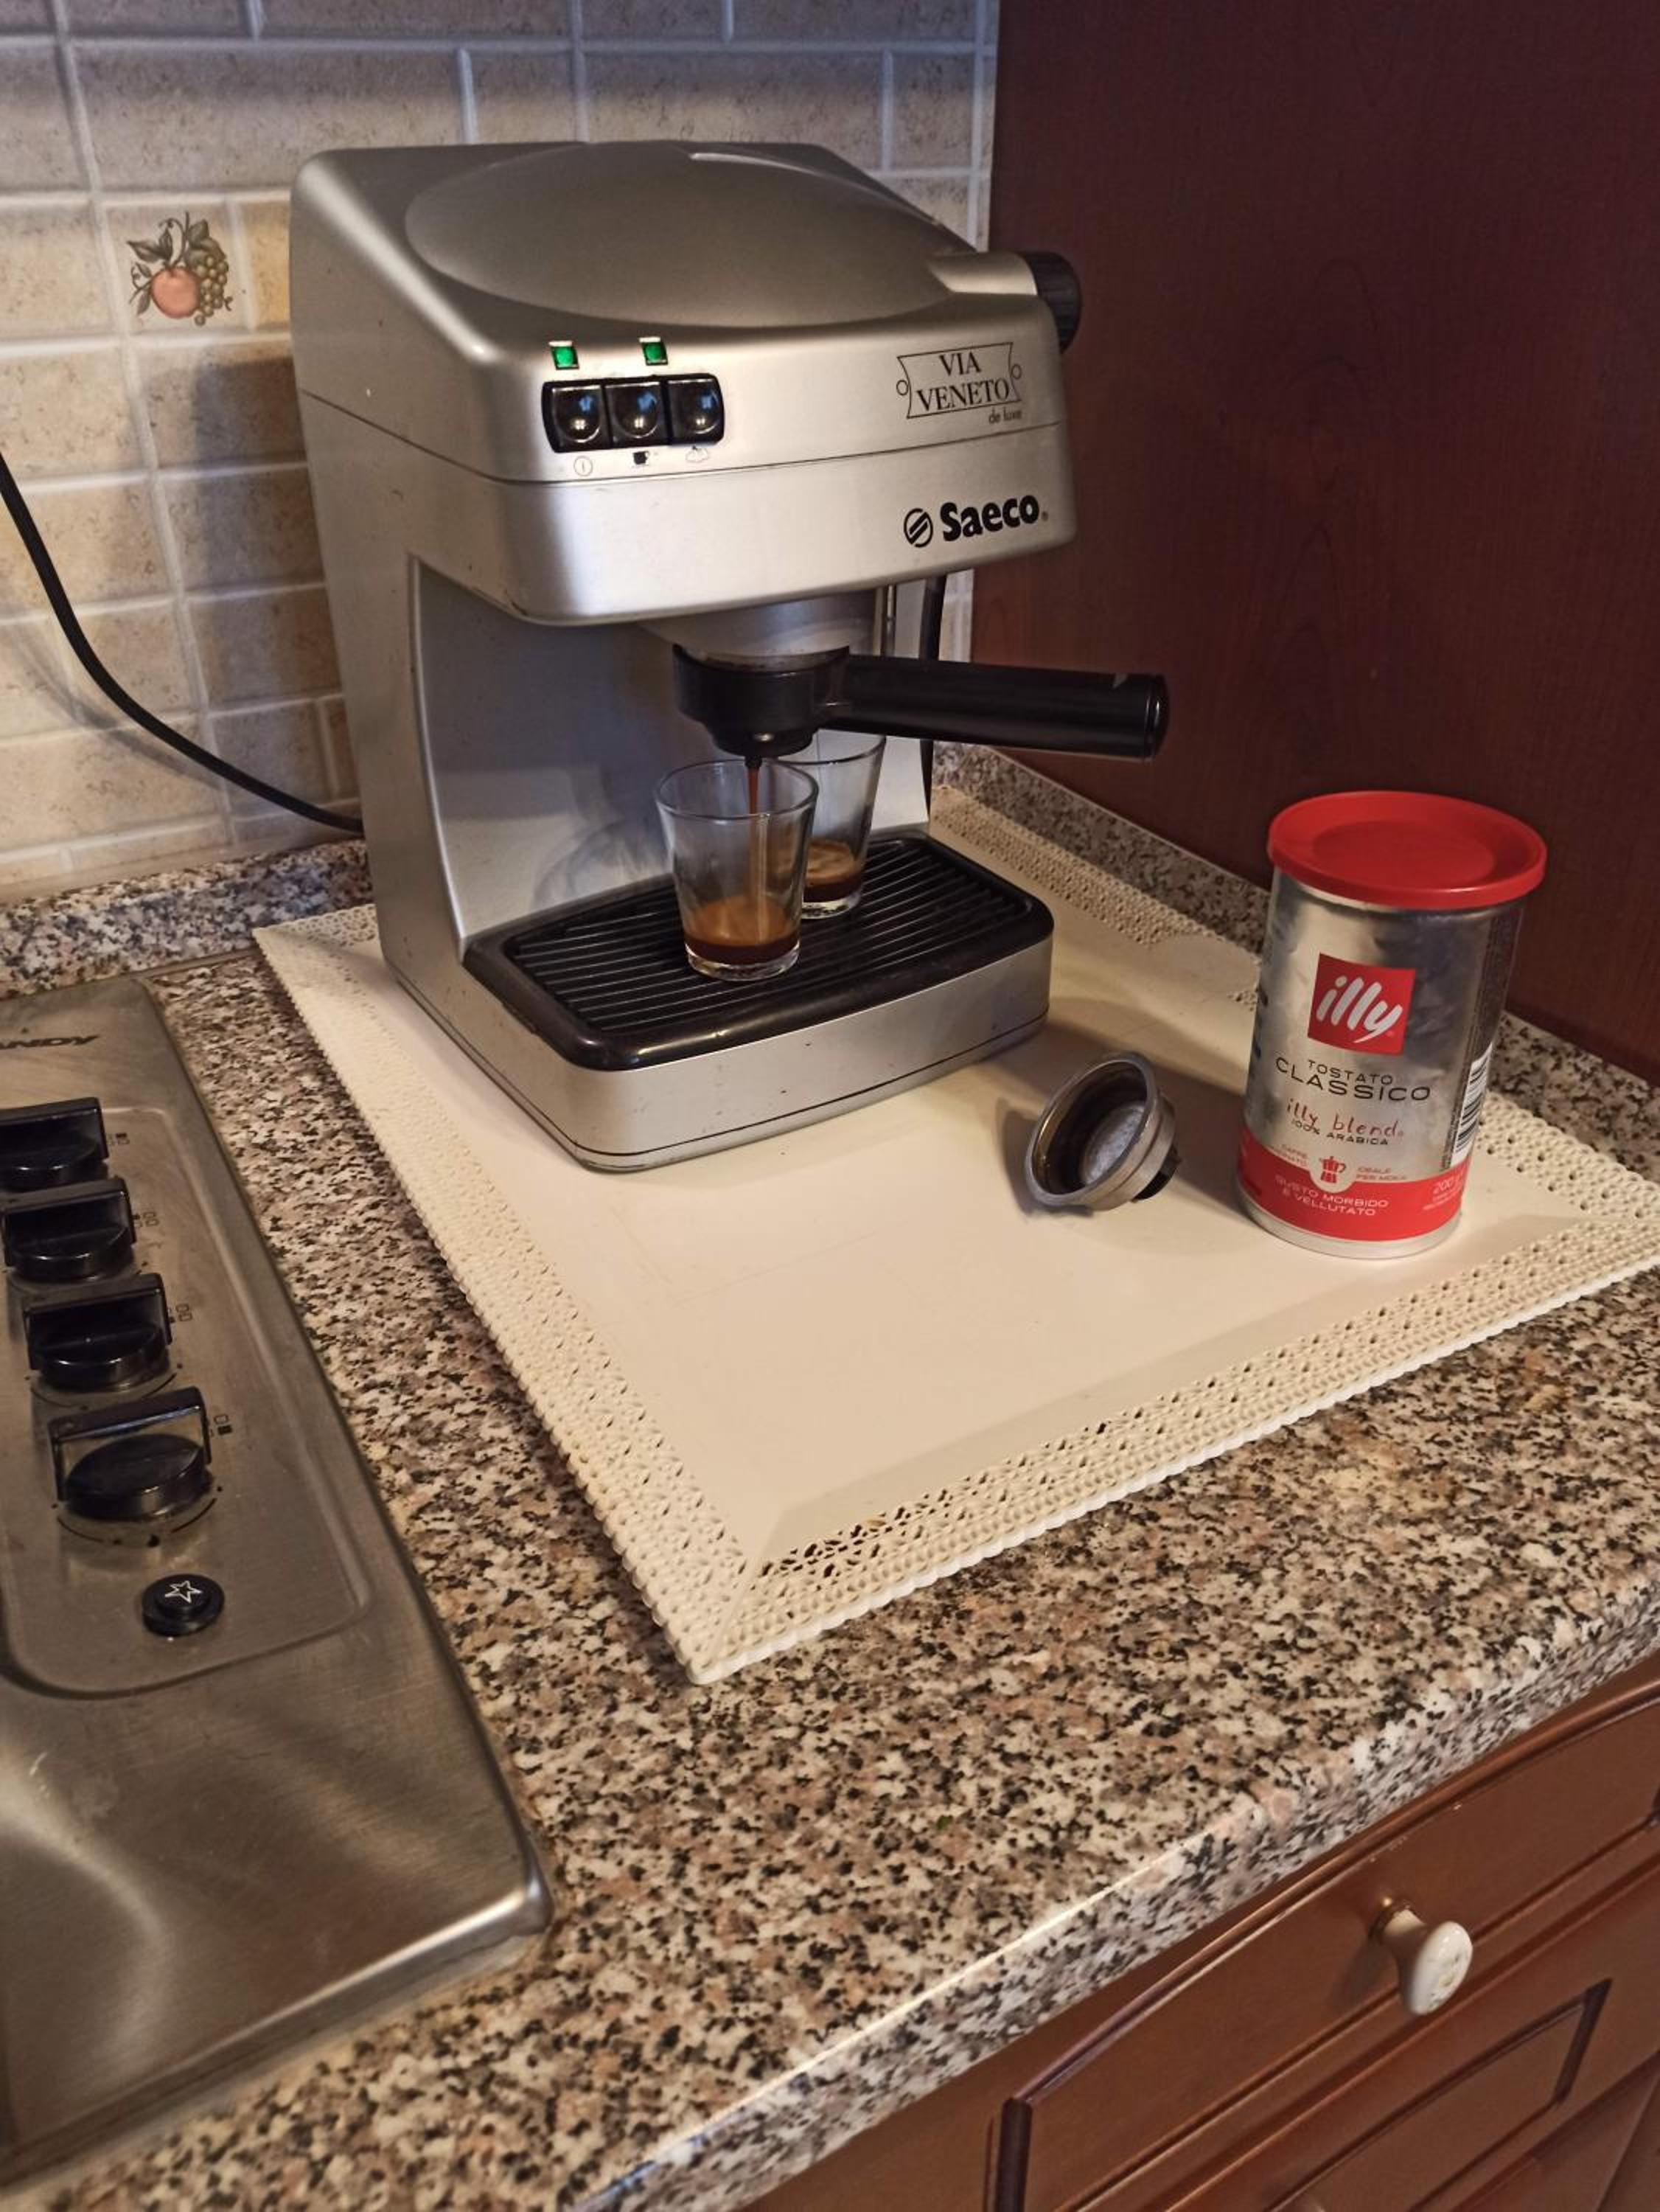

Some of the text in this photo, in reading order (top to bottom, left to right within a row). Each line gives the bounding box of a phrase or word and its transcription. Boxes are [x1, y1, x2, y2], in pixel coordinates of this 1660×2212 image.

[939, 352, 982, 376] VIA
[917, 378, 1010, 411] VENETO
[940, 495, 1040, 541] Saeco
[1316, 975, 1403, 1043] illy
[1275, 1057, 1431, 1102] CLASSICO
[1307, 1059, 1393, 1085] TOSTATO
[1287, 1098, 1399, 1137] illy blend
[1326, 1133, 1389, 1145] ARABICA
[1295, 1194, 1377, 1216] VELLUTATO
[1323, 1193, 1389, 1208] MORBIDO
